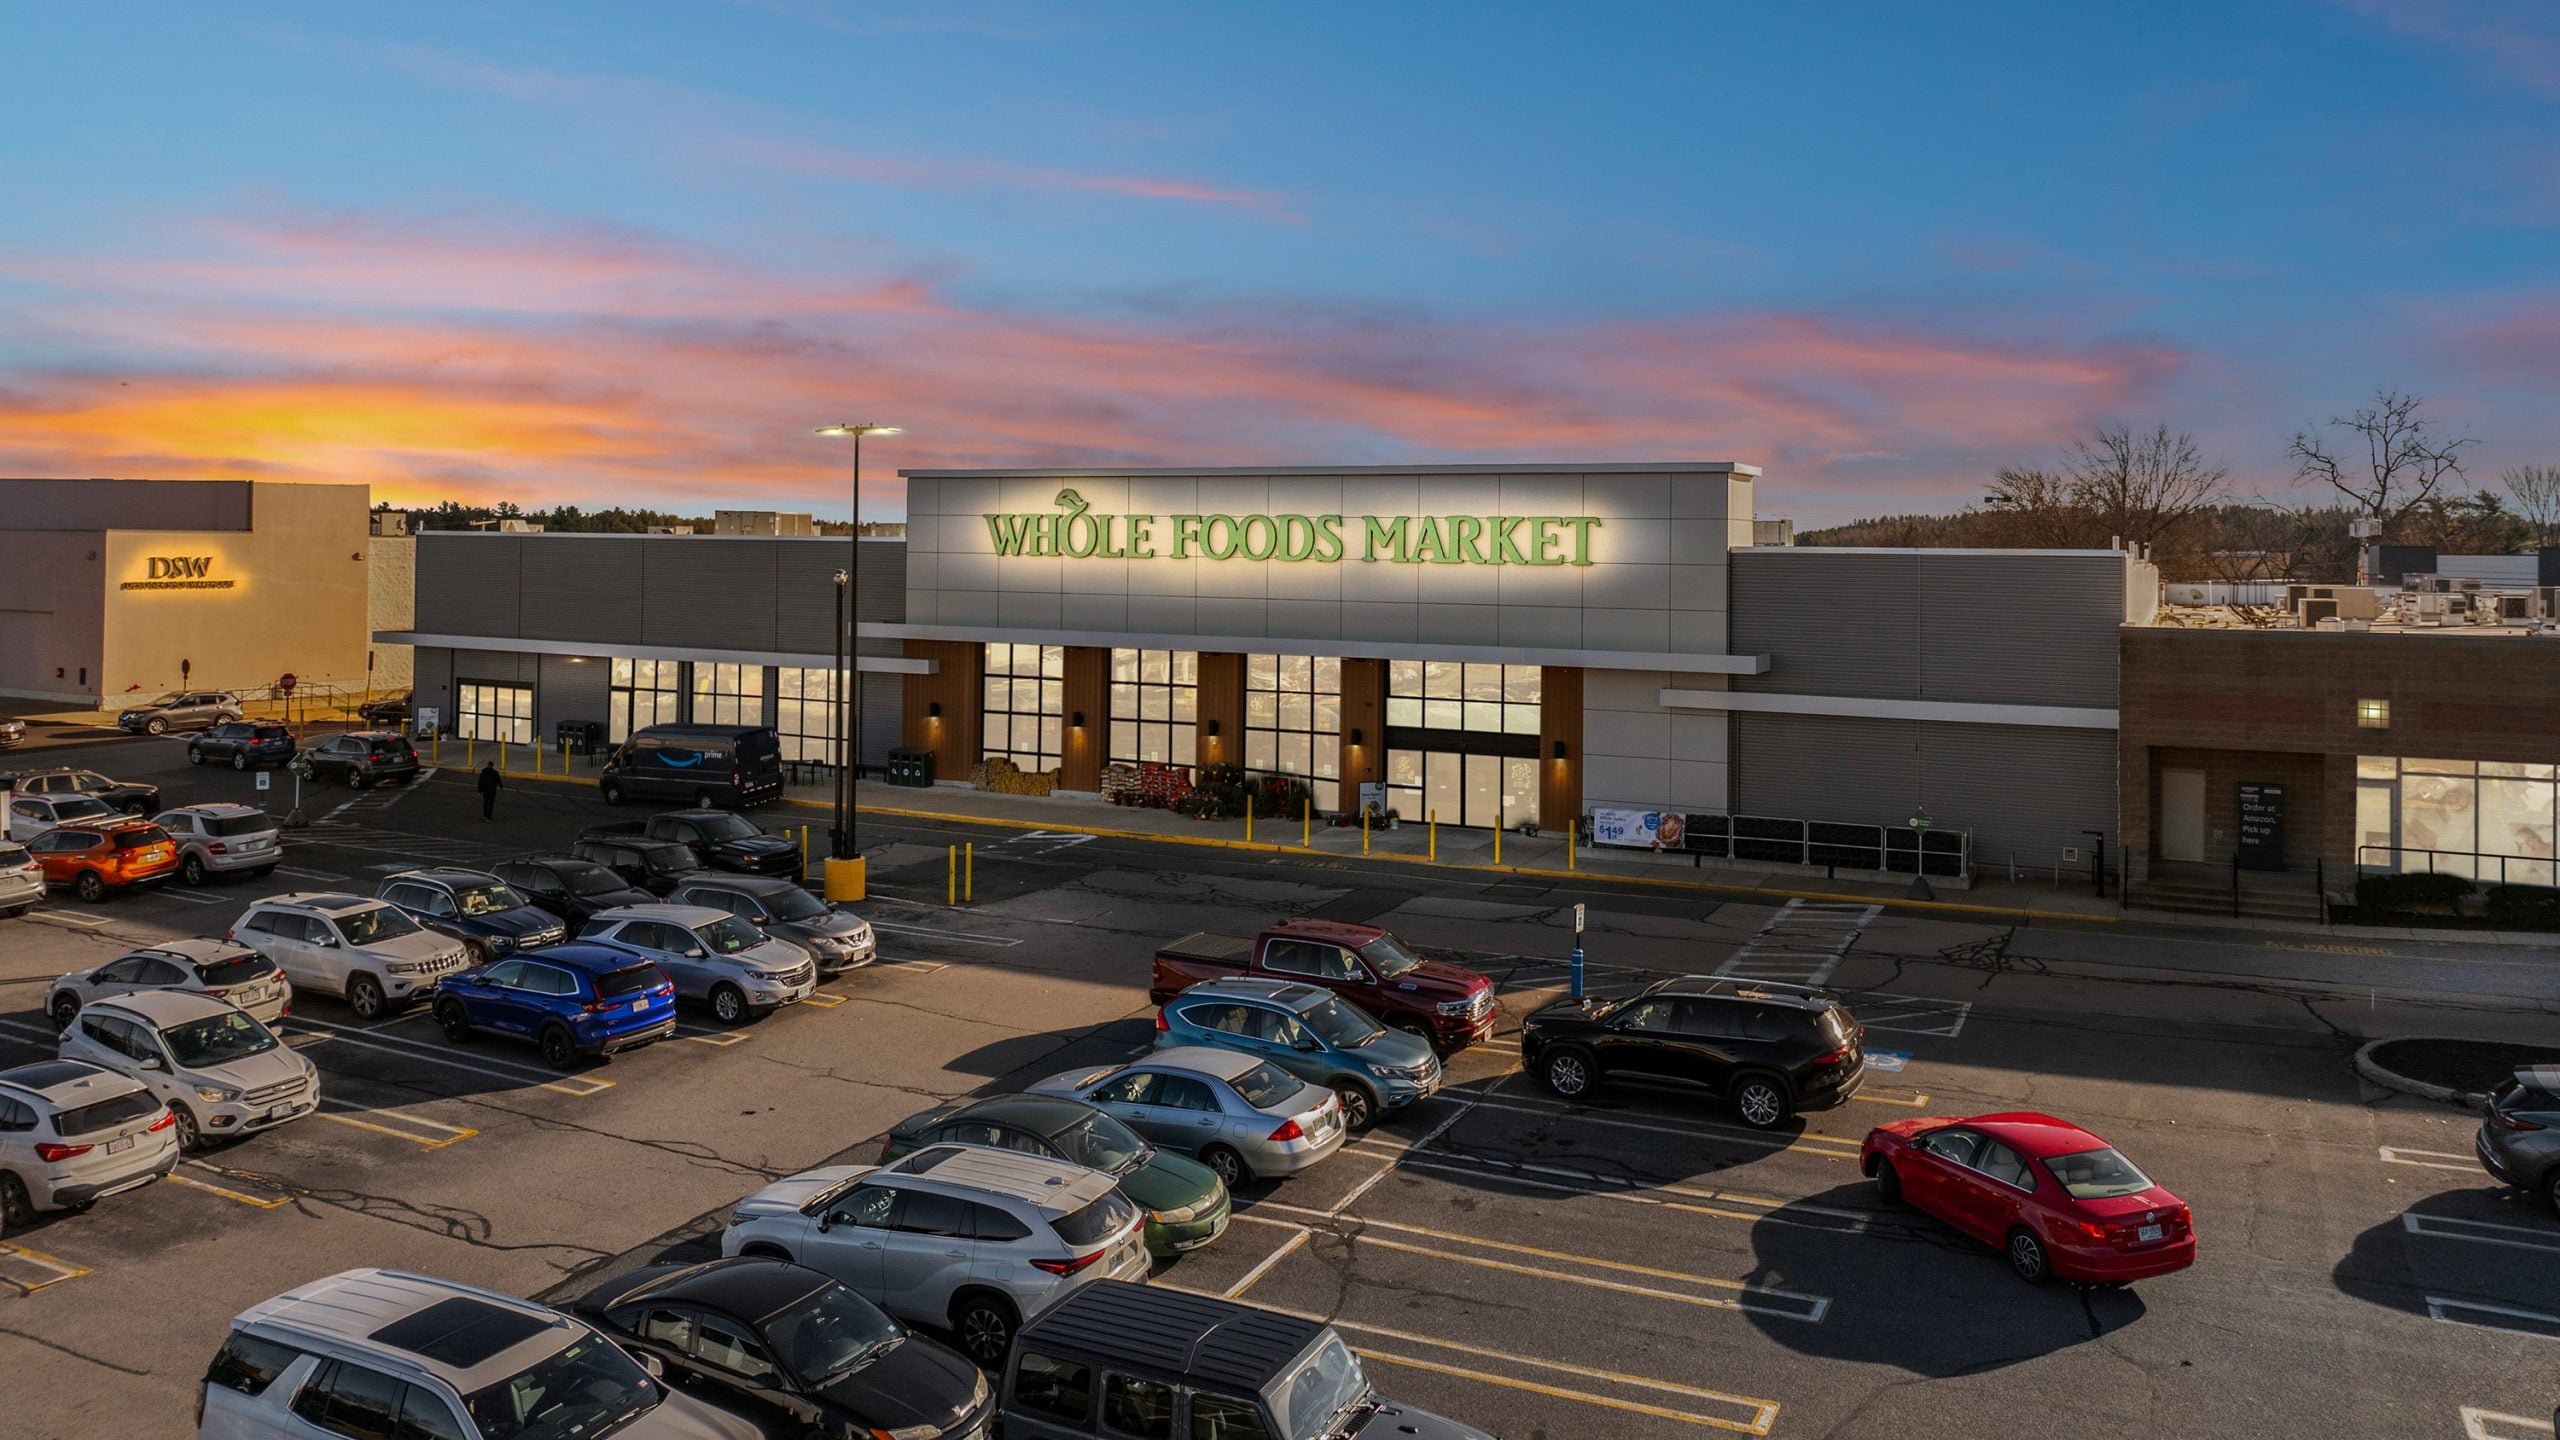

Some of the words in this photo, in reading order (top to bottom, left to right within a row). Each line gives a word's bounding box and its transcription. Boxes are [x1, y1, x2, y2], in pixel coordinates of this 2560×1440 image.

[983, 503, 1154, 559] WHOLE
[1170, 513, 1343, 563] FOODS
[1360, 514, 1602, 567] MARKET
[146, 556, 214, 579] DSW
[282, 678, 295, 686] STOP
[704, 750, 723, 760] prime
[2243, 803, 2265, 812] Order
[2242, 825, 2258, 834] Pick
[2260, 827, 2271, 835] up
[2242, 836, 2260, 846] here
